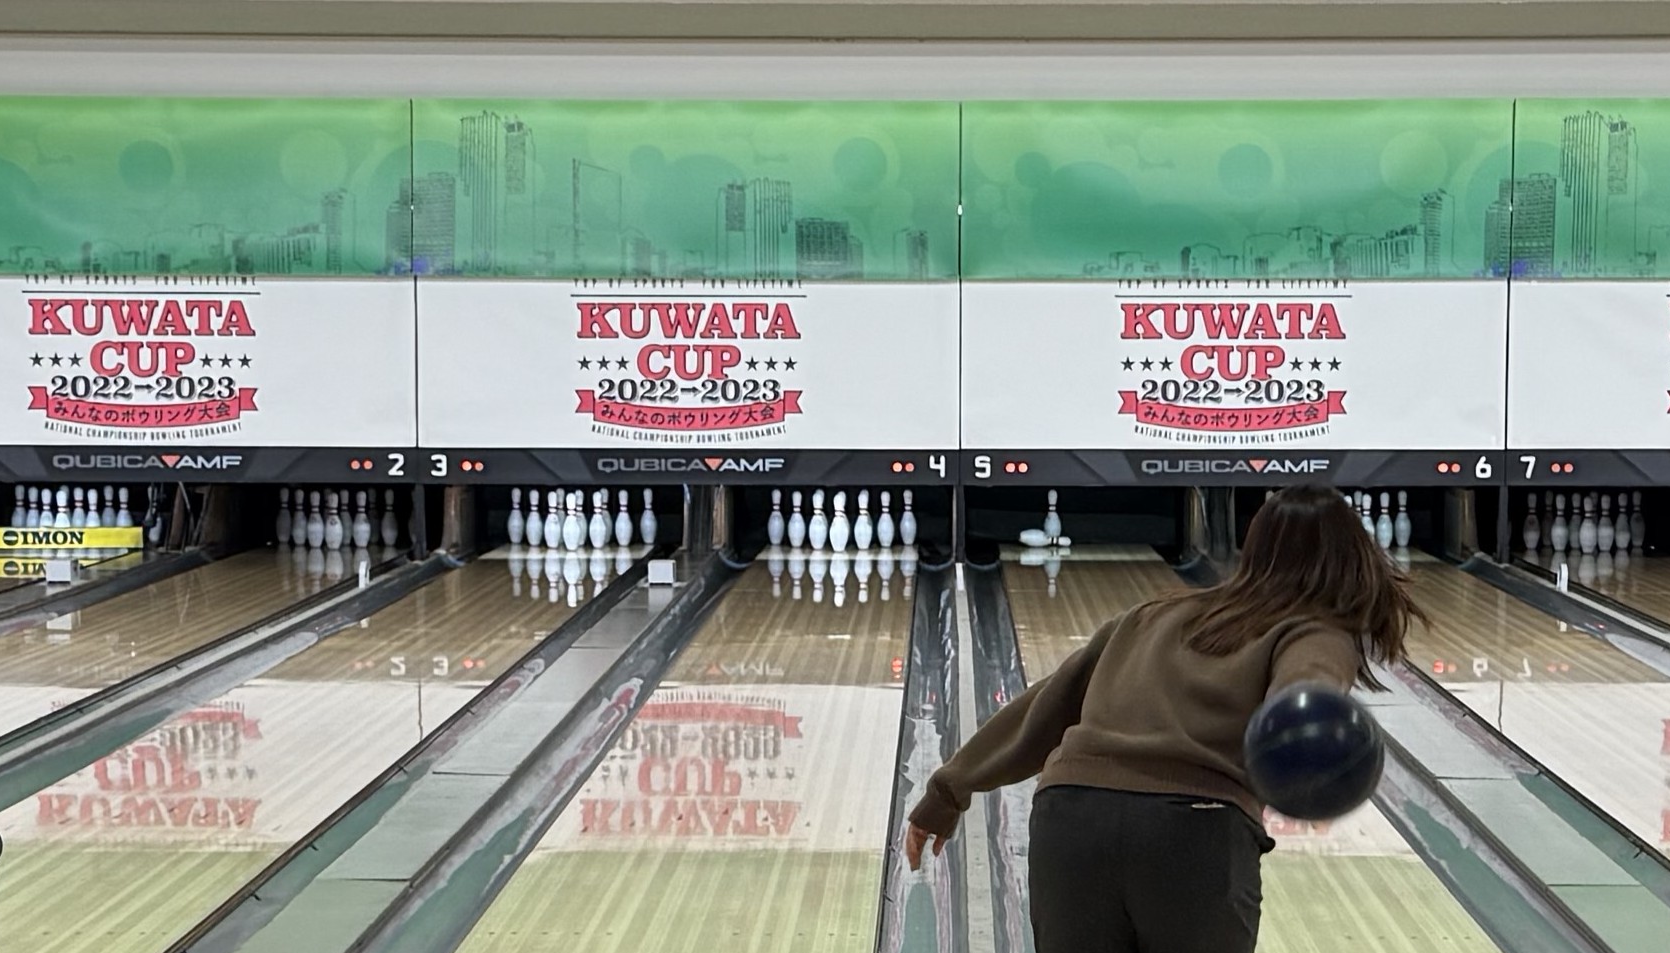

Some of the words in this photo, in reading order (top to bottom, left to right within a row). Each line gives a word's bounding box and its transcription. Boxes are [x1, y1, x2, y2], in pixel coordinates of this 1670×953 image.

[28, 298, 256, 337] KUWATA
[576, 302, 801, 339] KUWATA
[1120, 303, 1346, 340] KUWATA
[90, 340, 196, 377] CUP
[636, 343, 741, 381] CUP
[1180, 345, 1285, 381] CUP
[53, 402, 232, 425] みんなのボウリング大会
[601, 405, 776, 428] みんなのボウリング大会
[1144, 406, 1319, 428] みんなのボウリング大会
[388, 453, 405, 476] 2
[430, 454, 447, 477] 3
[929, 455, 946, 478] 4
[974, 456, 991, 478] 5
[1475, 457, 1492, 479] 6
[1520, 457, 1536, 479] 7
[20, 529, 85, 545] IMON
